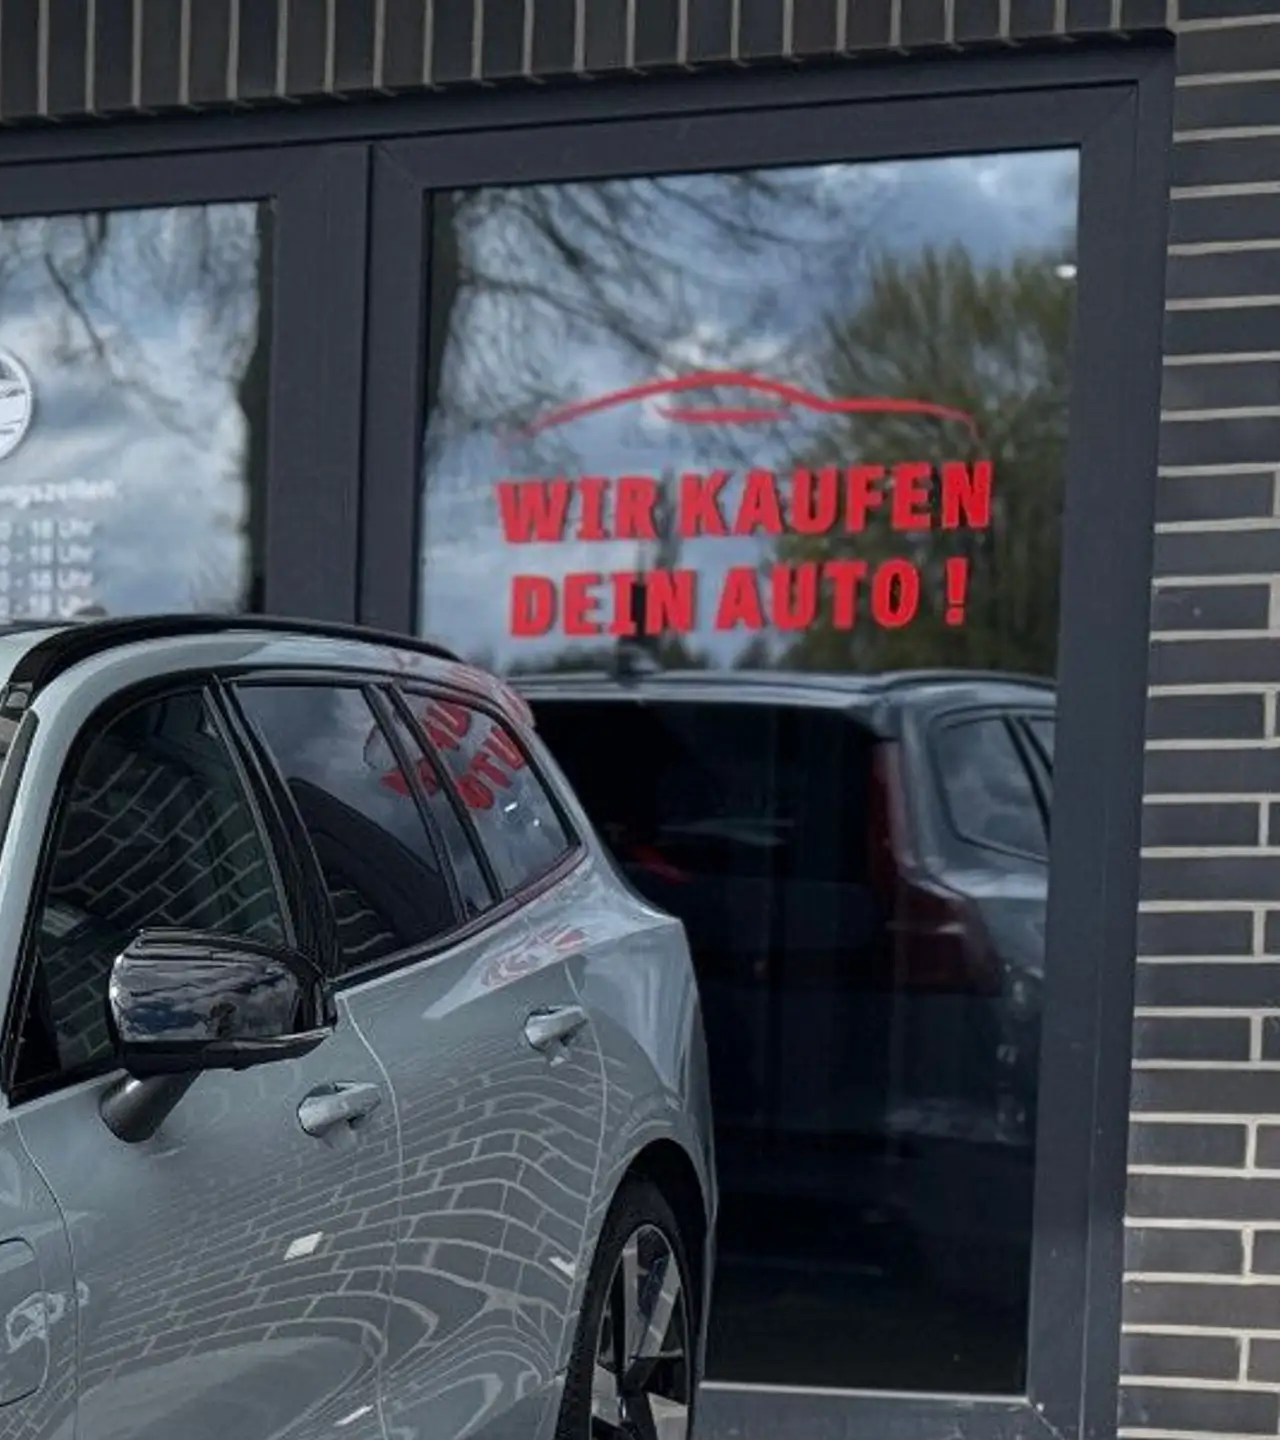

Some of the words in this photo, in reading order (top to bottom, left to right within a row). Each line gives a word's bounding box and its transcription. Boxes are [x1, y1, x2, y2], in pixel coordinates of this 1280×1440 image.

[495, 475, 659, 544] WIR
[679, 460, 992, 538] KAUFEN
[509, 568, 697, 637] DEIN
[715, 557, 920, 630] AUTO
[944, 556, 970, 626] !
